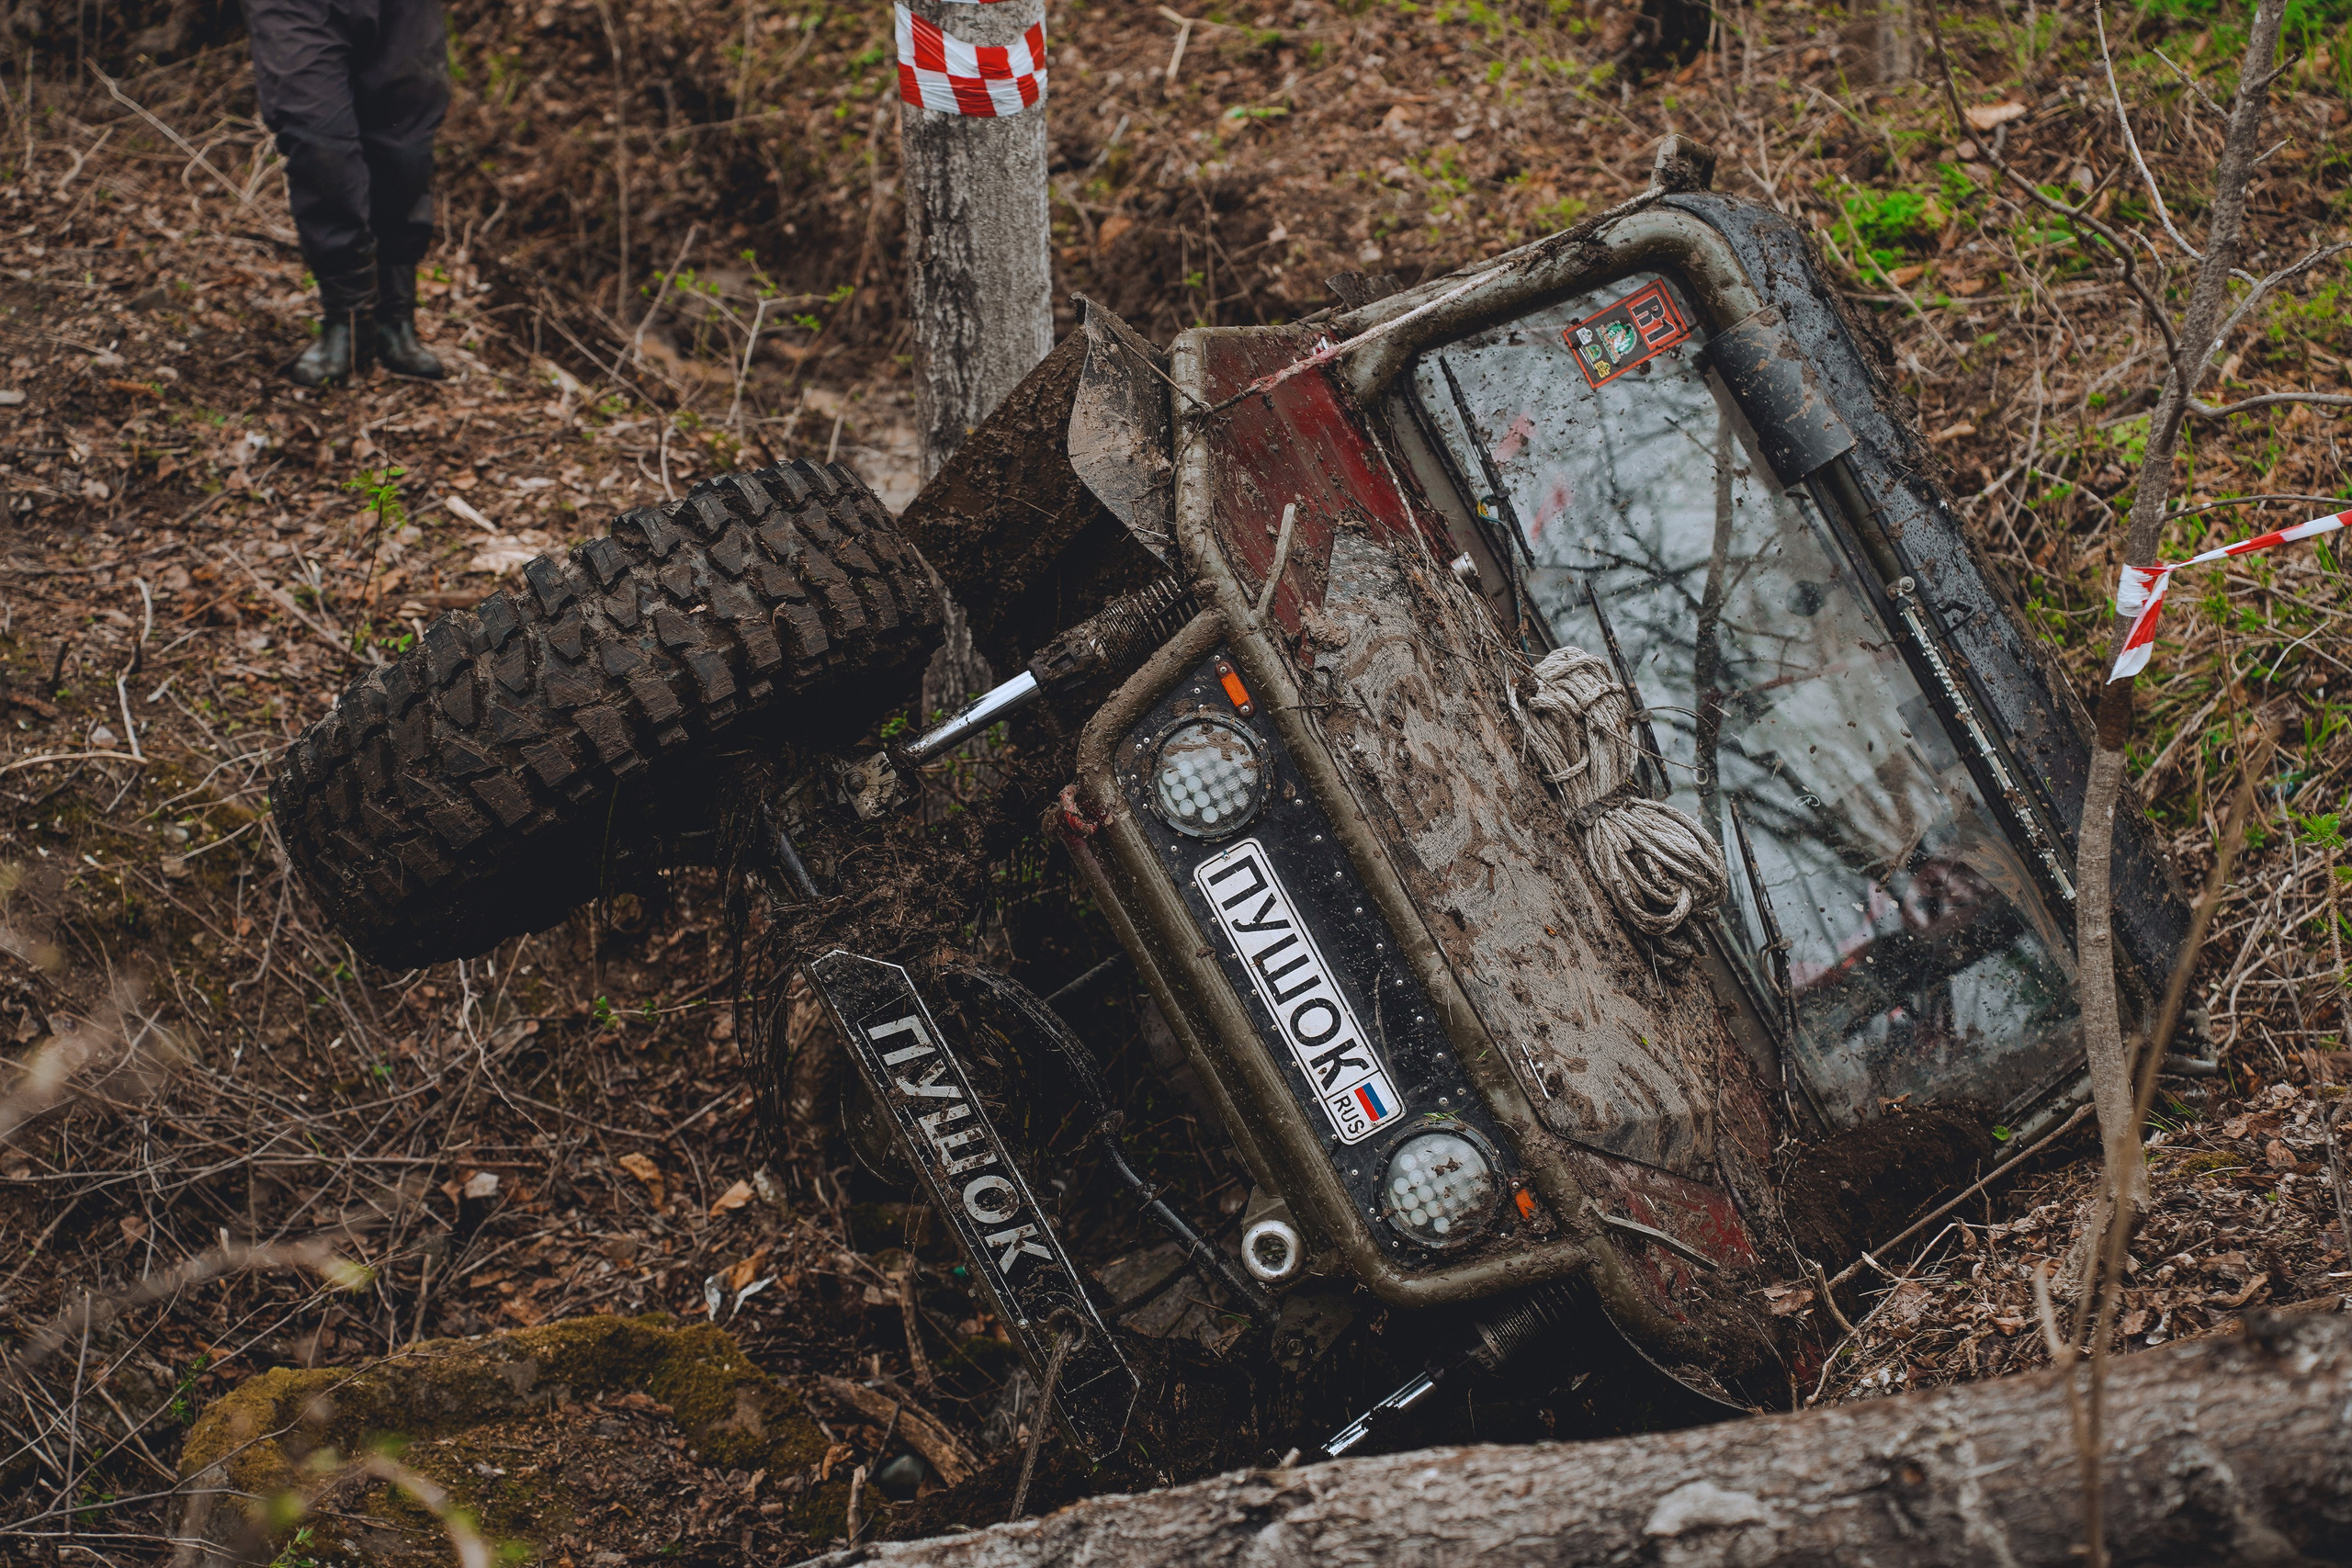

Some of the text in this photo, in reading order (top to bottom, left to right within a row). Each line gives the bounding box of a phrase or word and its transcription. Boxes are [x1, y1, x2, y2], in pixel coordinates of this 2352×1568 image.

[1631, 294, 1677, 344] R1
[1206, 854, 1370, 1091] ПУШОК
[868, 1014, 1053, 1274] ПУШОК
[1333, 1096, 1364, 1134] RUS
